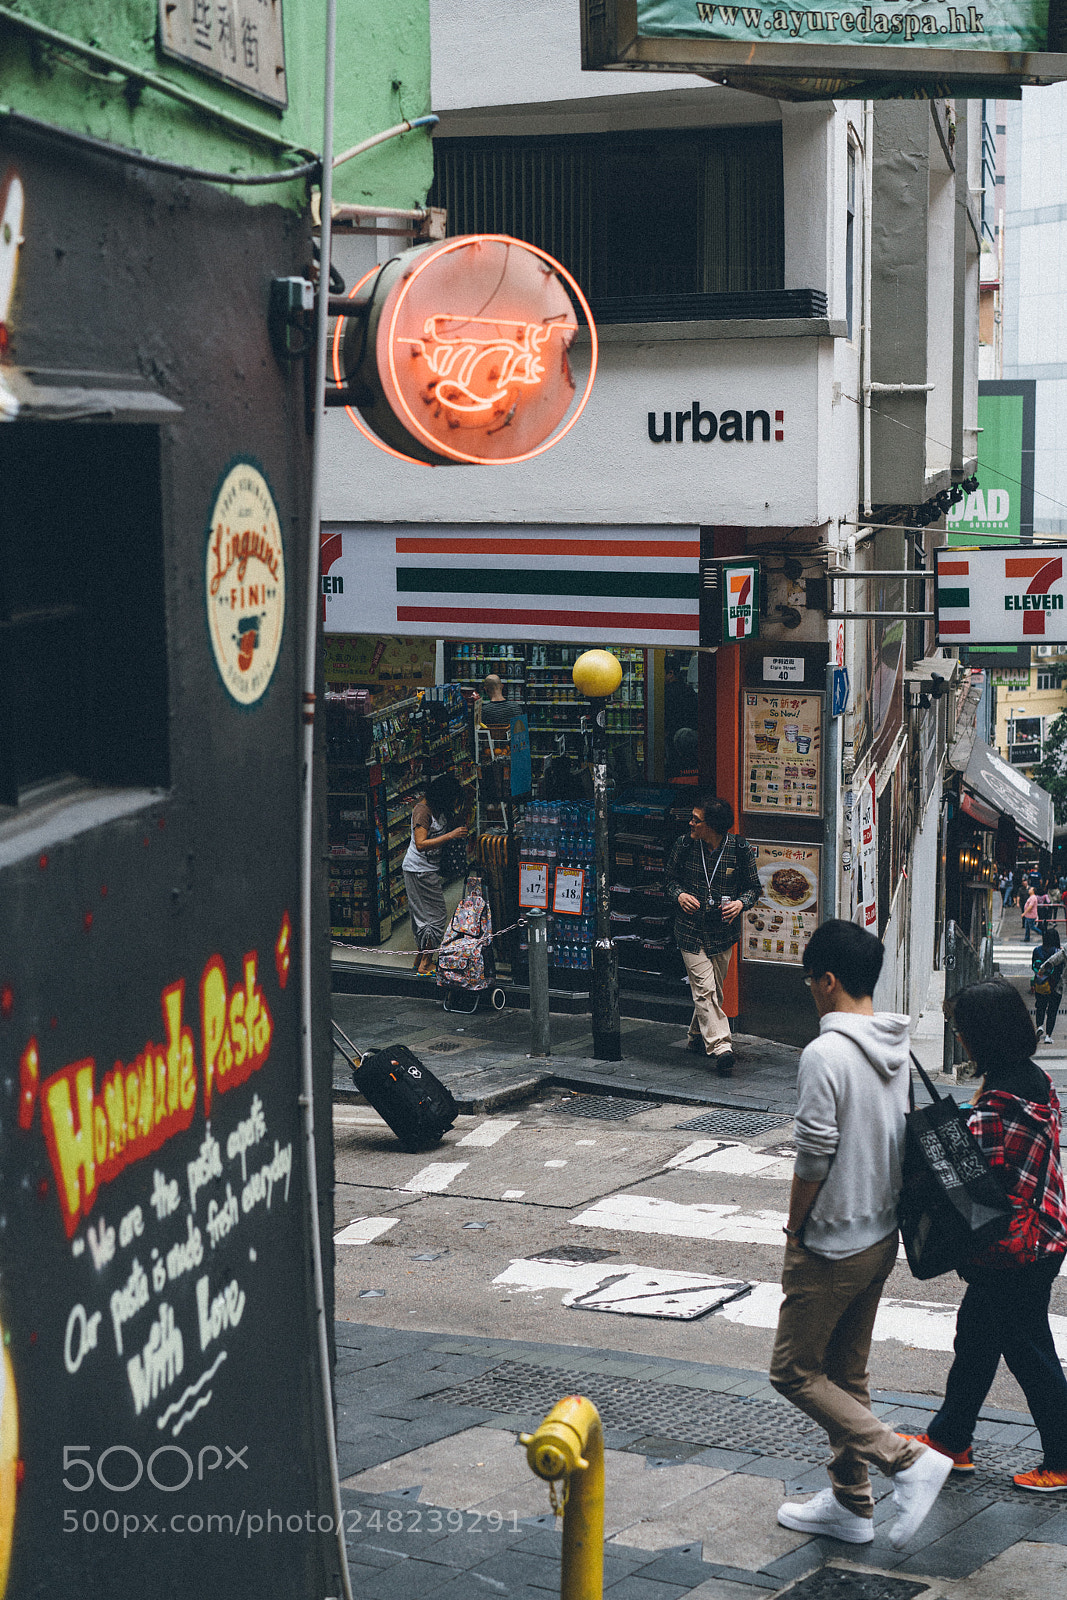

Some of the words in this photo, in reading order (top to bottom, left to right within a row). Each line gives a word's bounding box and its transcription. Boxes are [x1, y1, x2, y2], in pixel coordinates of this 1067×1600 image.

[696, 2, 984, 40] www.ayuredaspa.hk
[647, 401, 785, 443] urban:
[230, 584, 266, 610] FINI
[778, 671, 789, 680] 40
[769, 709, 779, 717] So
[201, 952, 273, 1117] Pasta
[118, 1205, 145, 1248] are
[150, 1169, 181, 1221] the
[187, 1121, 223, 1214] pasta
[166, 1214, 204, 1281] made
[206, 1182, 239, 1250] fresh
[241, 1140, 292, 1214] everyday
